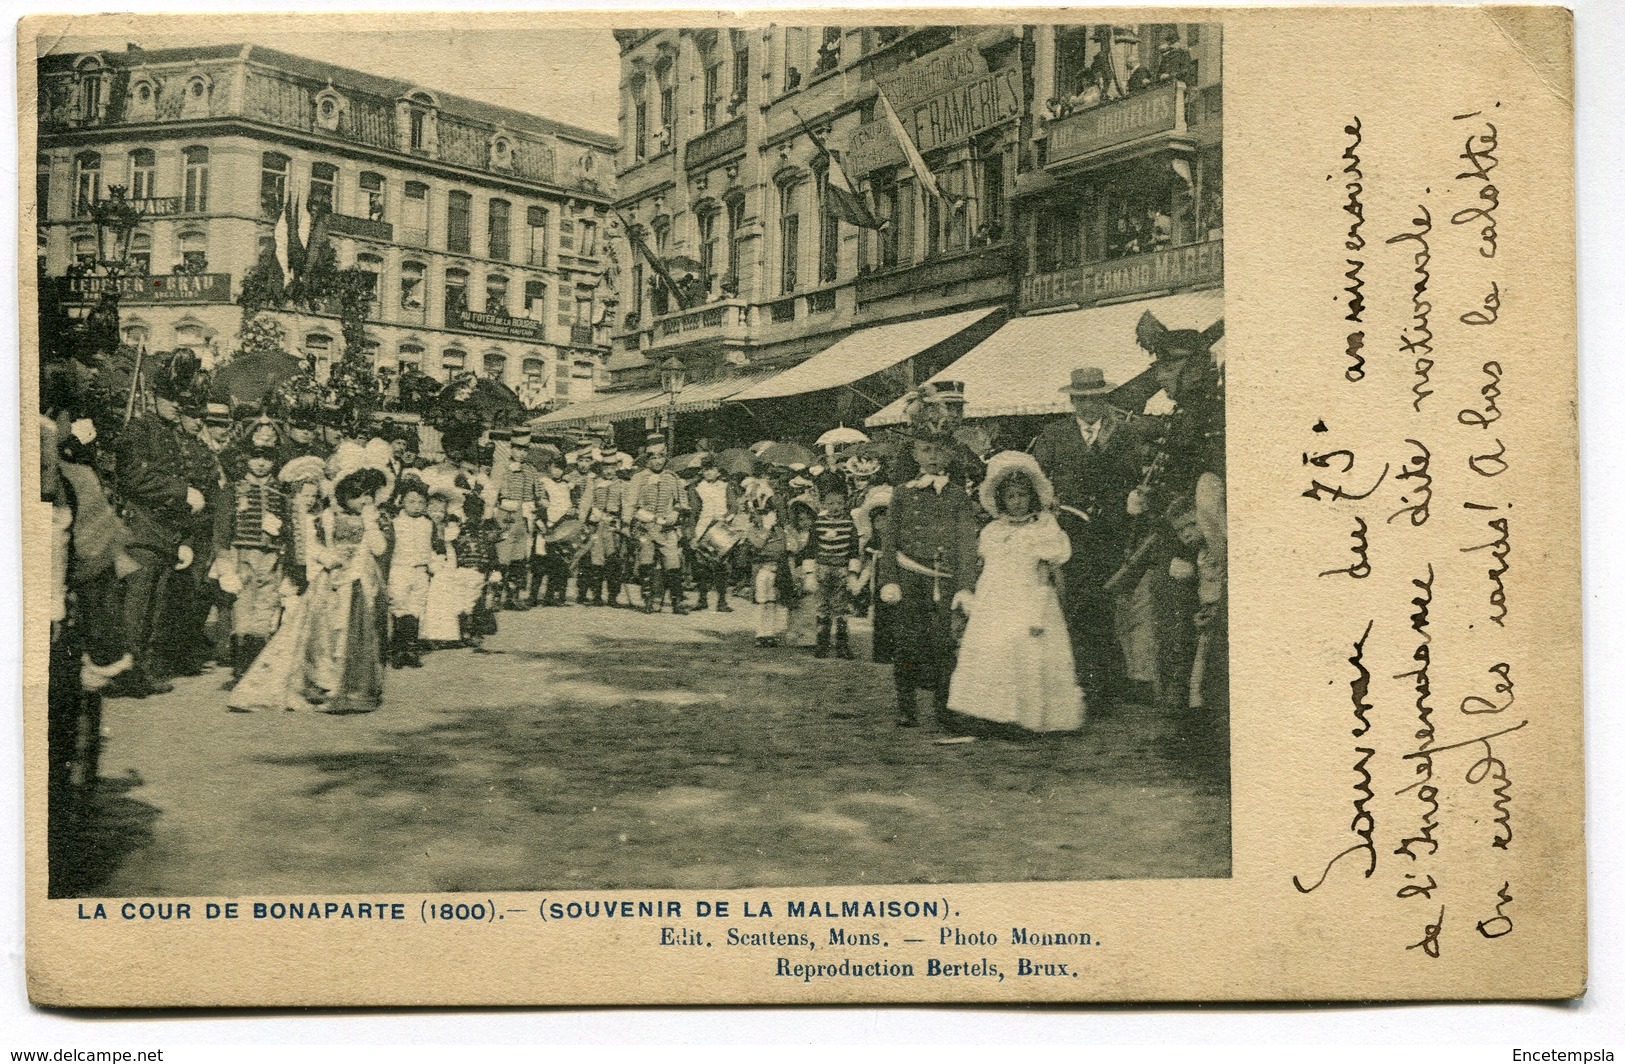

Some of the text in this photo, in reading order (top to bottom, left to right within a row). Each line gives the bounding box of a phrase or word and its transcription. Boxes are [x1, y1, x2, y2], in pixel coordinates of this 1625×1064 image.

[913, 68, 1019, 150] FRAMERIES
[1098, 94, 1170, 136] BRUXELLES
[460, 311, 471, 320] AU
[472, 313, 496, 324] FOYER
[512, 319, 539, 329] BOURSE
[1459, 280, 1501, 327] la
[1457, 360, 1503, 431] bas
[1319, 517, 1371, 579] du
[1460, 662, 1516, 716] les
[1293, 620, 1375, 893] Souvenir
[77, 902, 108, 920] LA
[120, 902, 191, 920] COUR
[205, 902, 239, 920] DE
[253, 902, 406, 920] BONAPARTE
[538, 898, 682, 921] (SOUVENIR
[696, 900, 730, 918] DE
[743, 900, 773, 918] LA
[787, 897, 961, 921] MALMAISON).
[1406, 905, 1445, 959] de
[1475, 881, 1514, 940] On
[659, 927, 713, 948] Edit.
[726, 927, 816, 951] Scattens,
[828, 927, 889, 948] Mons.
[939, 926, 998, 946] Photo
[775, 957, 1079, 982] Reproduction Bertels, Brux.
